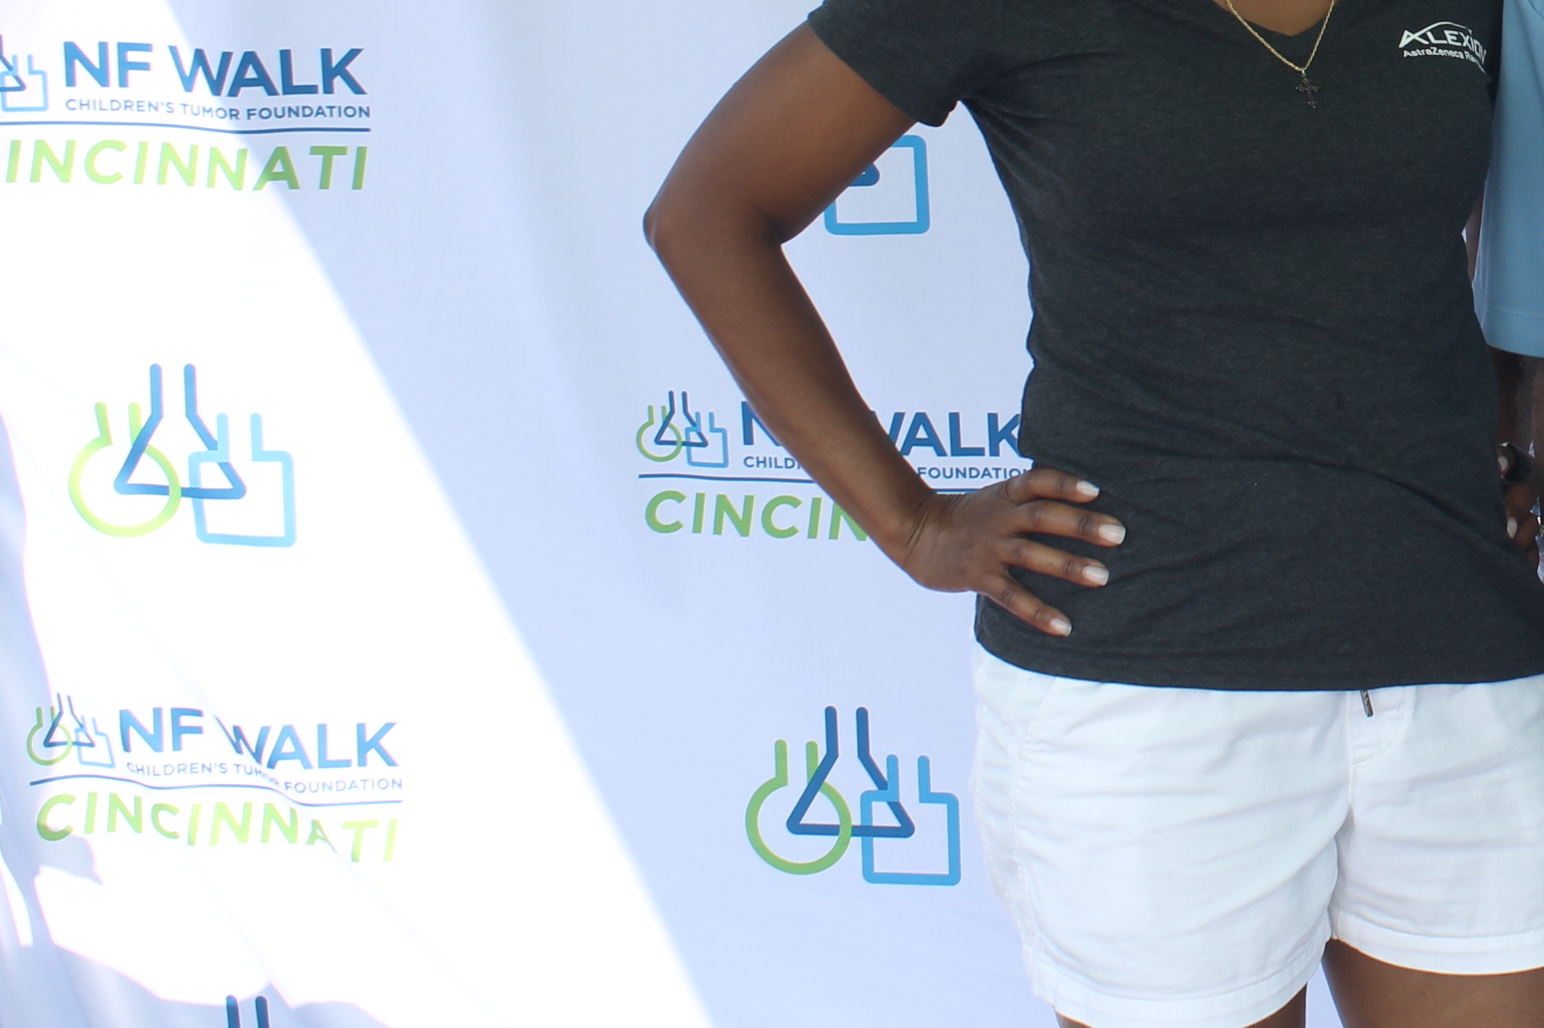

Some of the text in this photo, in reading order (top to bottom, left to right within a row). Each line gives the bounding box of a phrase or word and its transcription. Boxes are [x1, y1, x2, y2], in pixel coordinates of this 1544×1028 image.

[63, 41, 367, 97] NF WALK
[65, 99, 371, 122] CHILDREN'S TUMOR FOUNDATION
[888, 411, 1021, 458] ALK
[743, 455, 1028, 479] CHILD FOUNDATIO
[119, 707, 399, 770] NF WALK
[127, 762, 228, 777] CHILDREN'S
[284, 777, 403, 794] FOUNDATION
[37, 791, 398, 863] CINCINNATI
